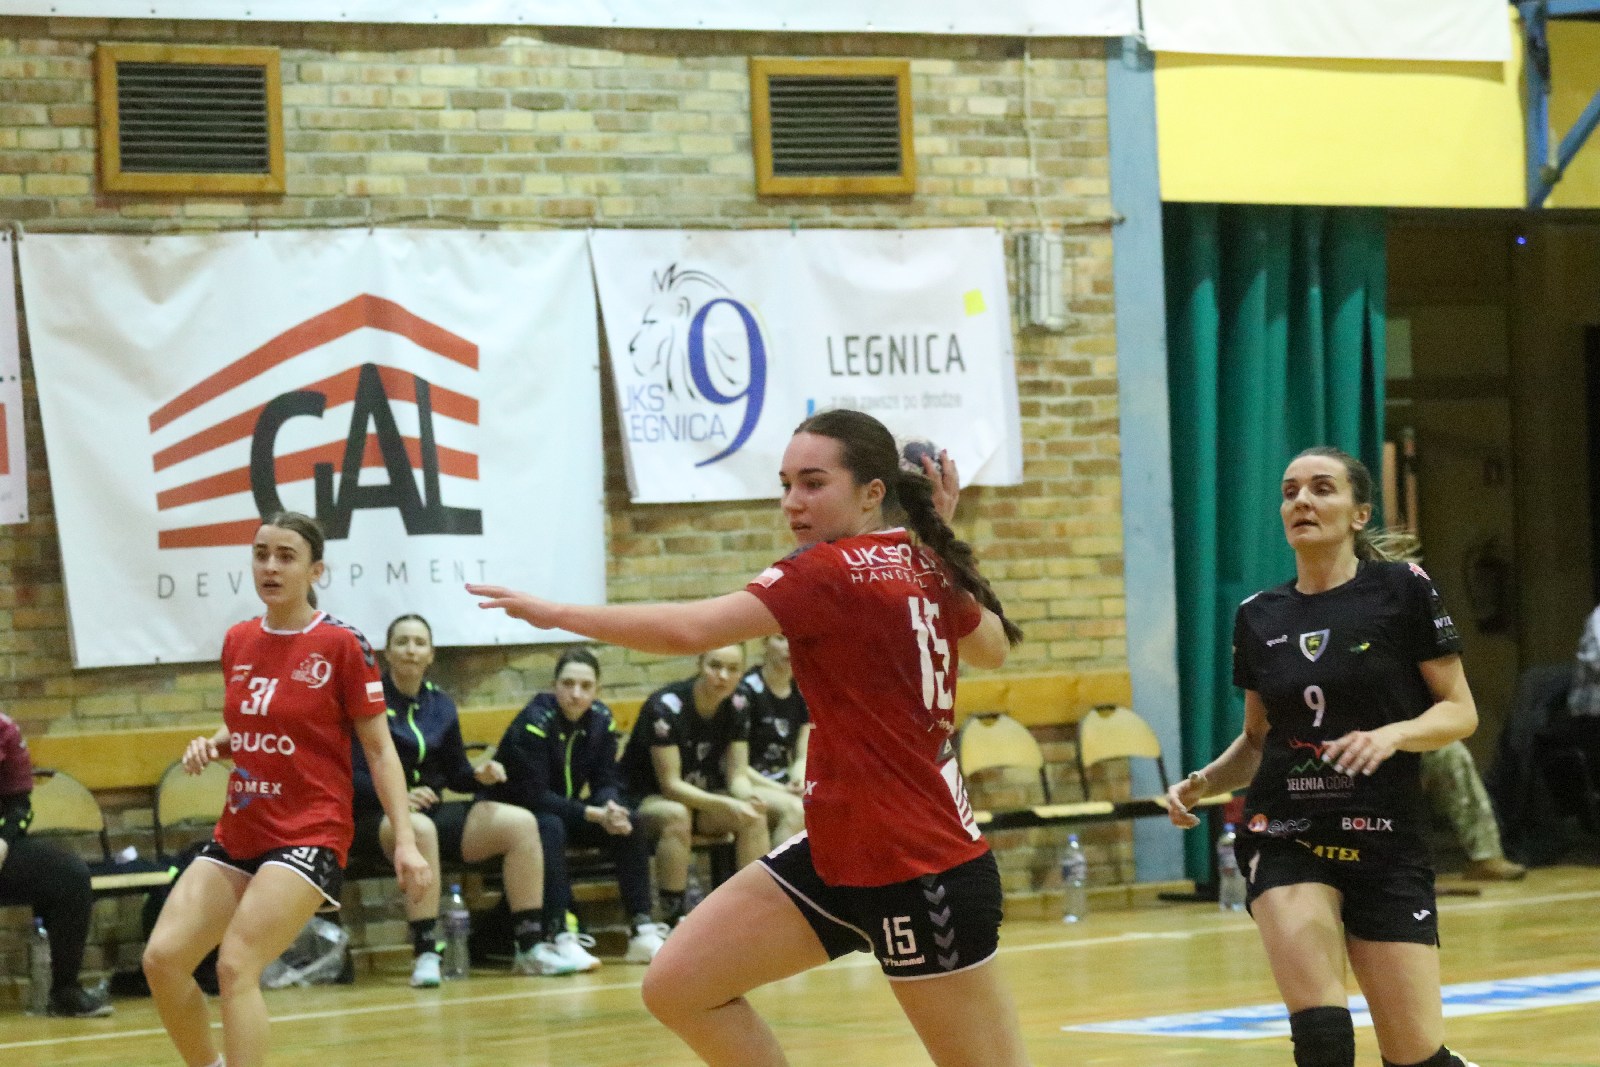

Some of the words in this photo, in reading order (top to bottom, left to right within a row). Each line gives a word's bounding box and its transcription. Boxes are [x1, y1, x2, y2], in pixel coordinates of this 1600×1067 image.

[827, 333, 966, 376] LEGNICA
[688, 298, 767, 468] 9
[629, 413, 727, 442] EGNICA
[249, 363, 483, 540] GAL
[157, 559, 487, 600] DEVOPMENT
[908, 595, 954, 710] 15
[240, 676, 279, 716] 31
[1303, 685, 1326, 728] 9
[233, 780, 282, 796] OMEX
[1341, 816, 1394, 832] BOLIX
[882, 916, 917, 956] 15
